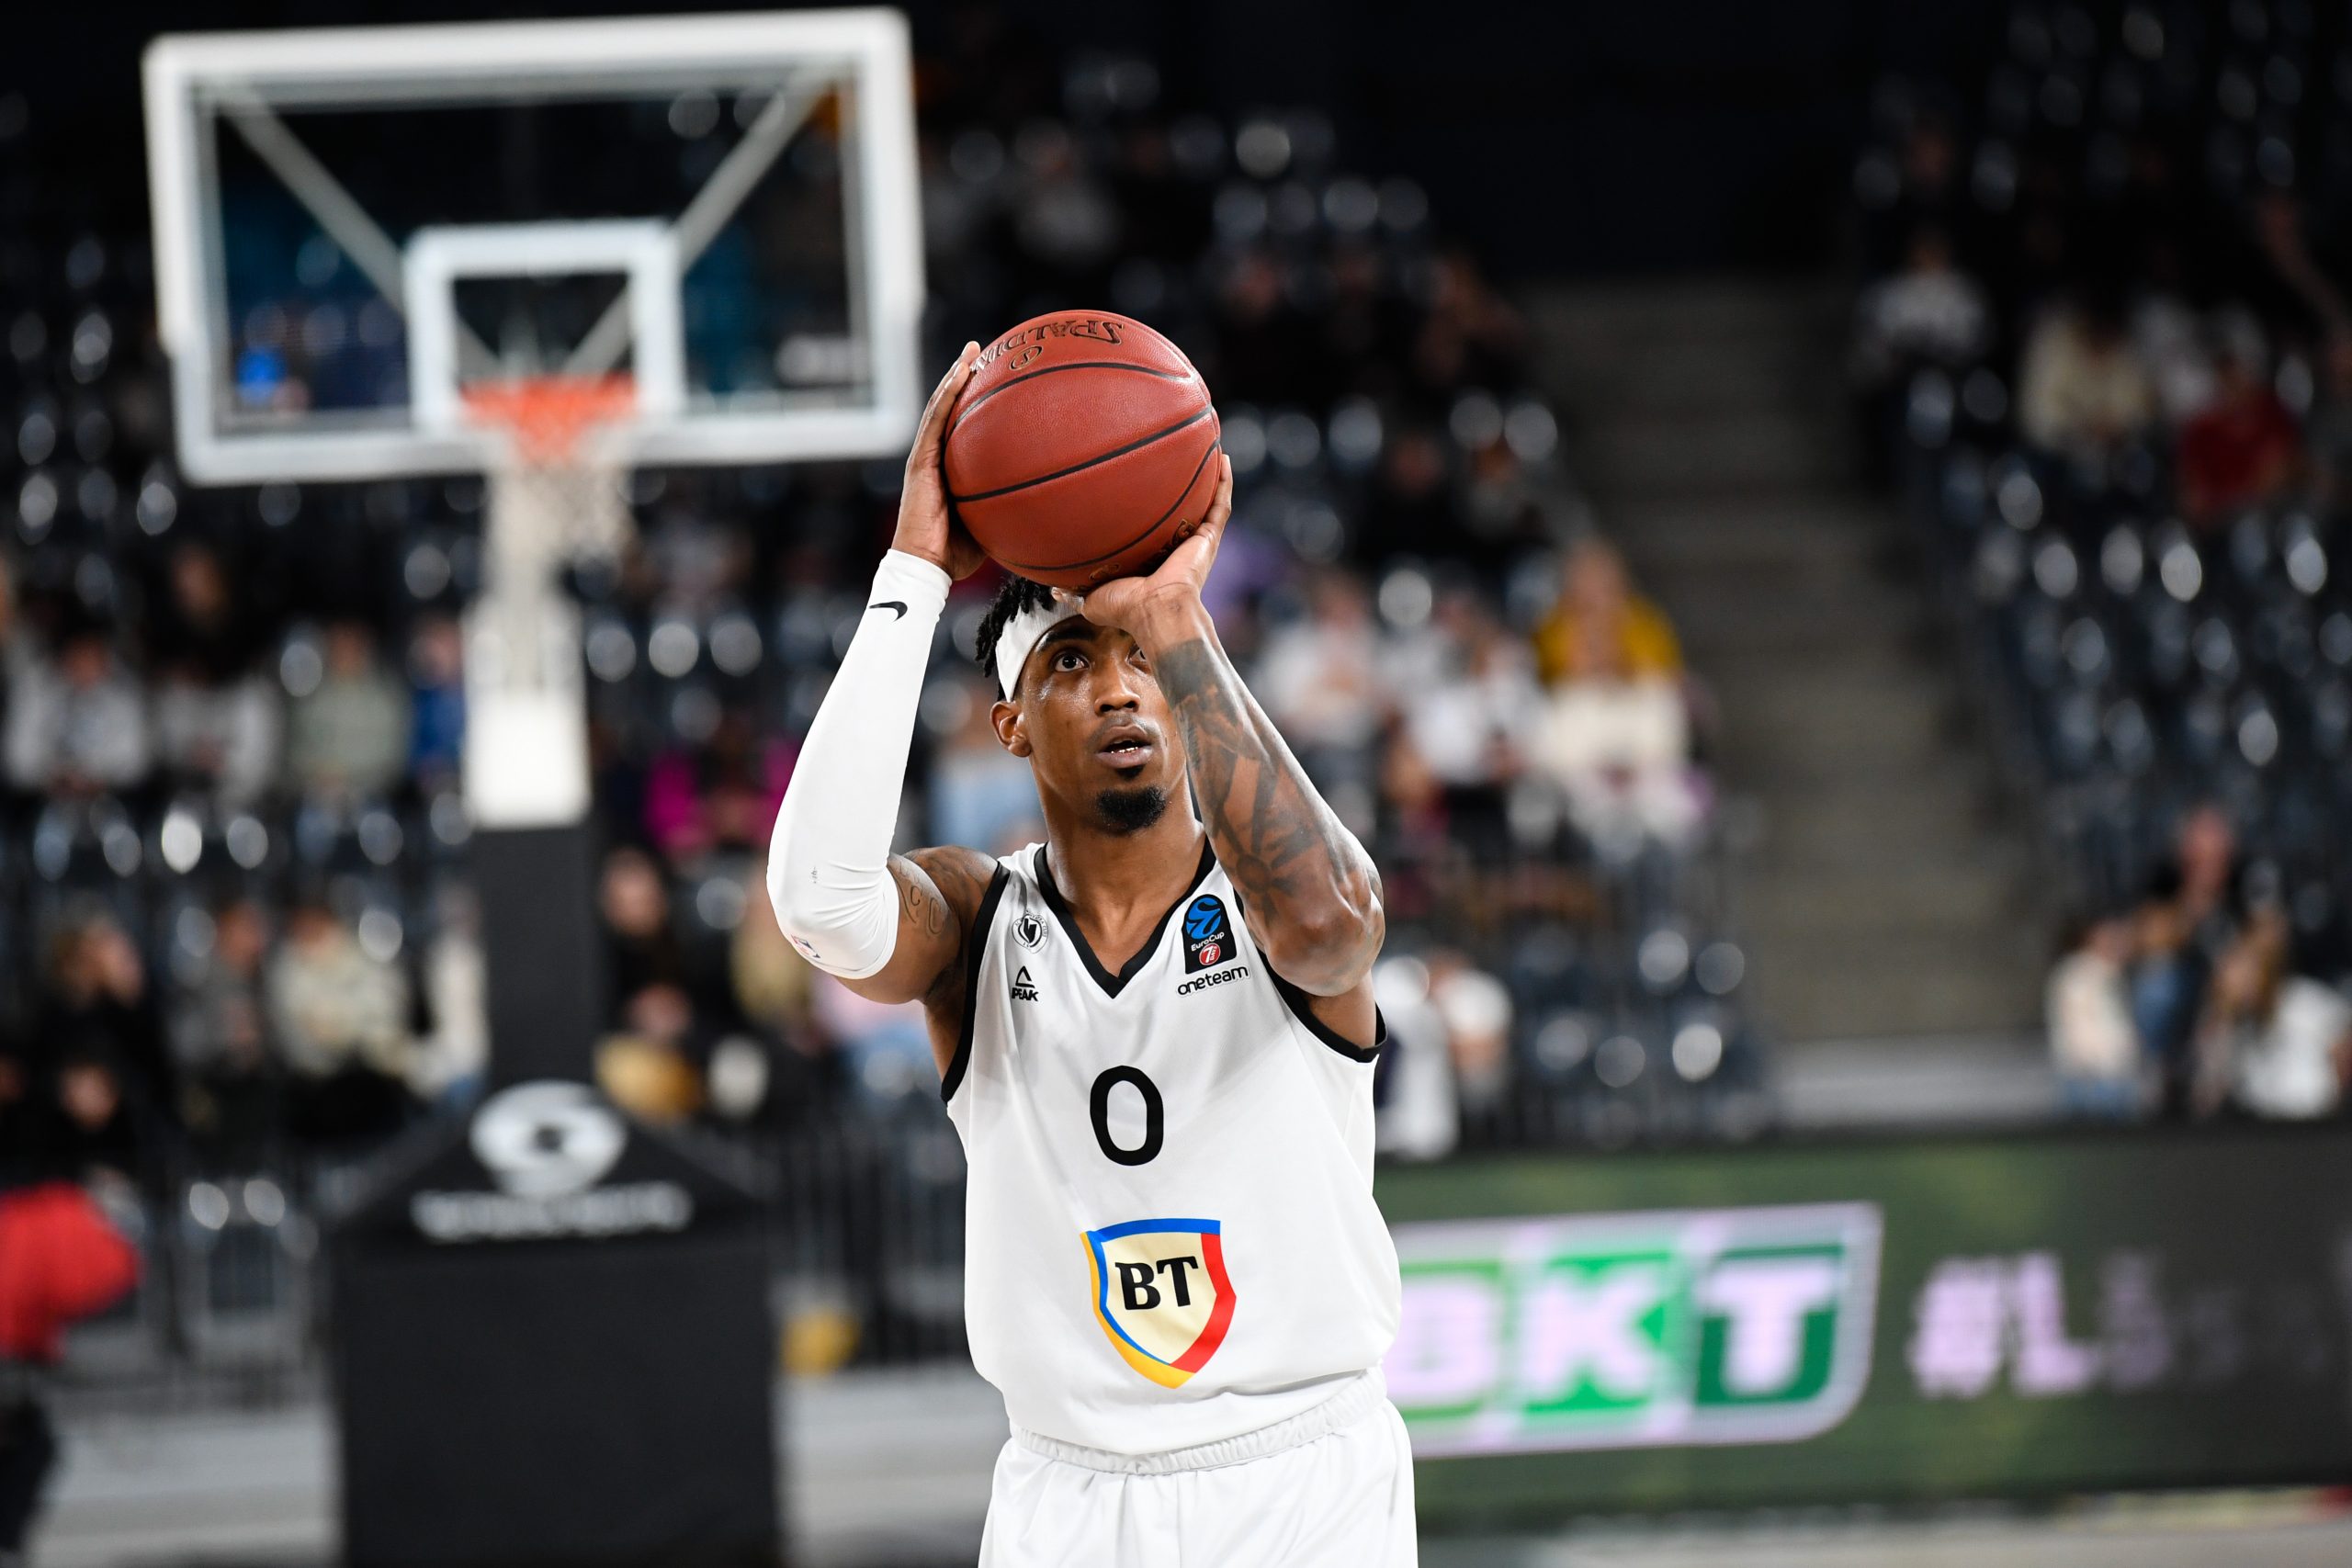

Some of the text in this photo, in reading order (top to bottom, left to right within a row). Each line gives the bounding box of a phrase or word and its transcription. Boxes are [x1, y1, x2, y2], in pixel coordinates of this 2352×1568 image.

[969, 321, 1125, 371] SPALDIN
[1191, 931, 1225, 952] EuroCup
[1012, 987, 1039, 1001] PEAK
[1178, 966, 1249, 996] oneteam
[1090, 1065, 1164, 1167] 0
[1114, 1256, 1199, 1311] BT
